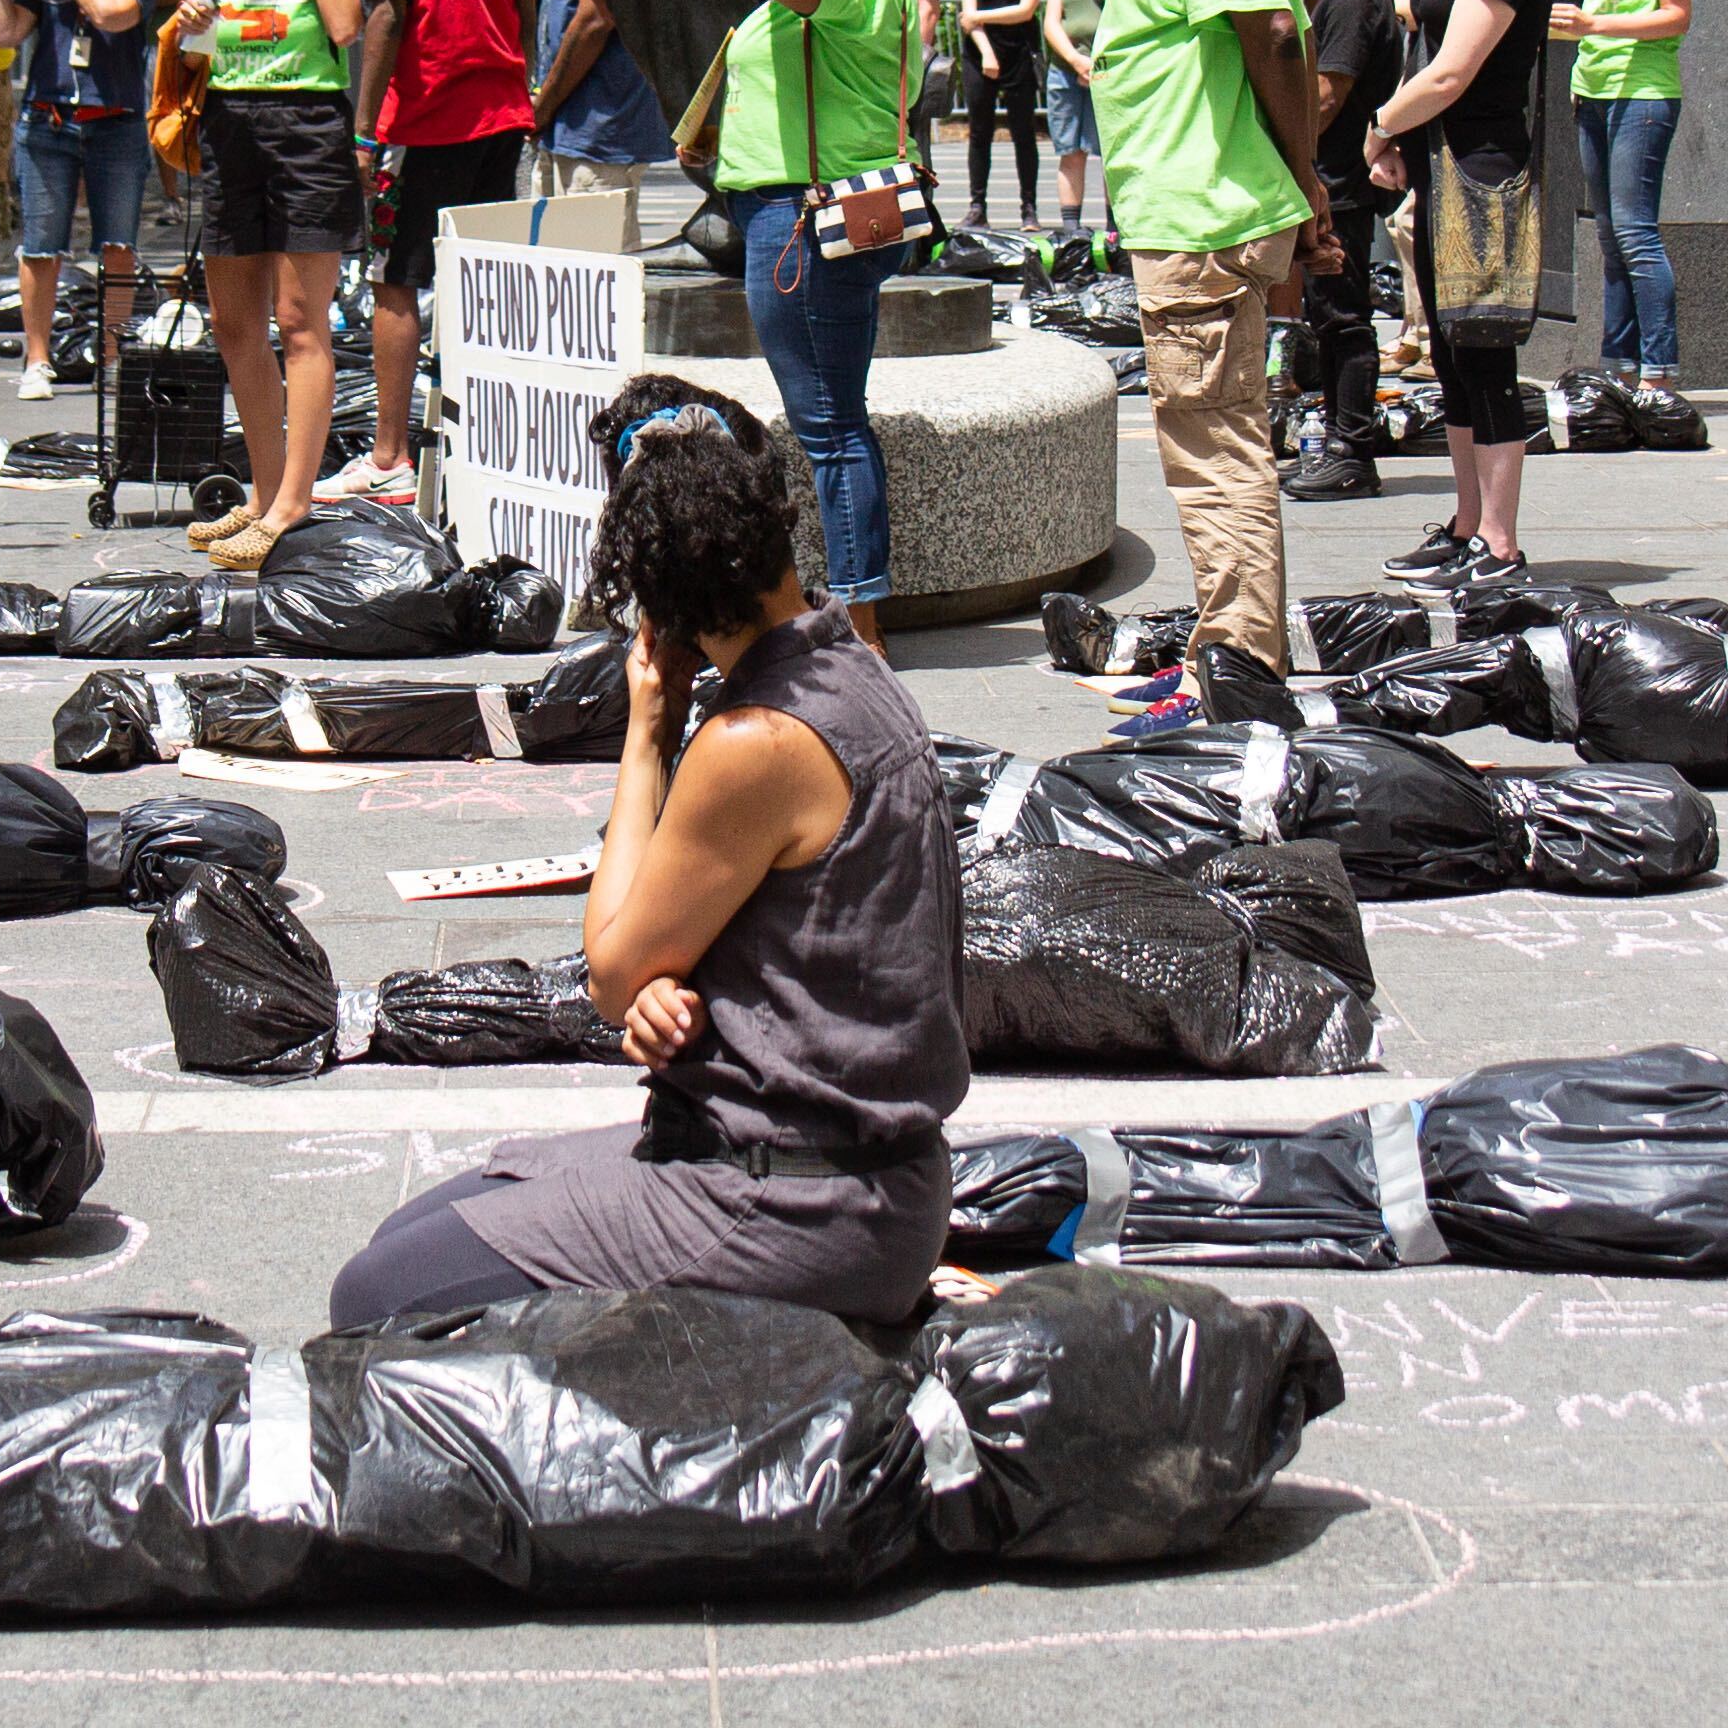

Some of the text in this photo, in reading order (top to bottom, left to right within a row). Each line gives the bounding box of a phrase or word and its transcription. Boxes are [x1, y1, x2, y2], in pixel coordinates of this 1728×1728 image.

[459, 256, 617, 362] DEFUND POLICE
[467, 375, 607, 493] FUND HOUSIN
